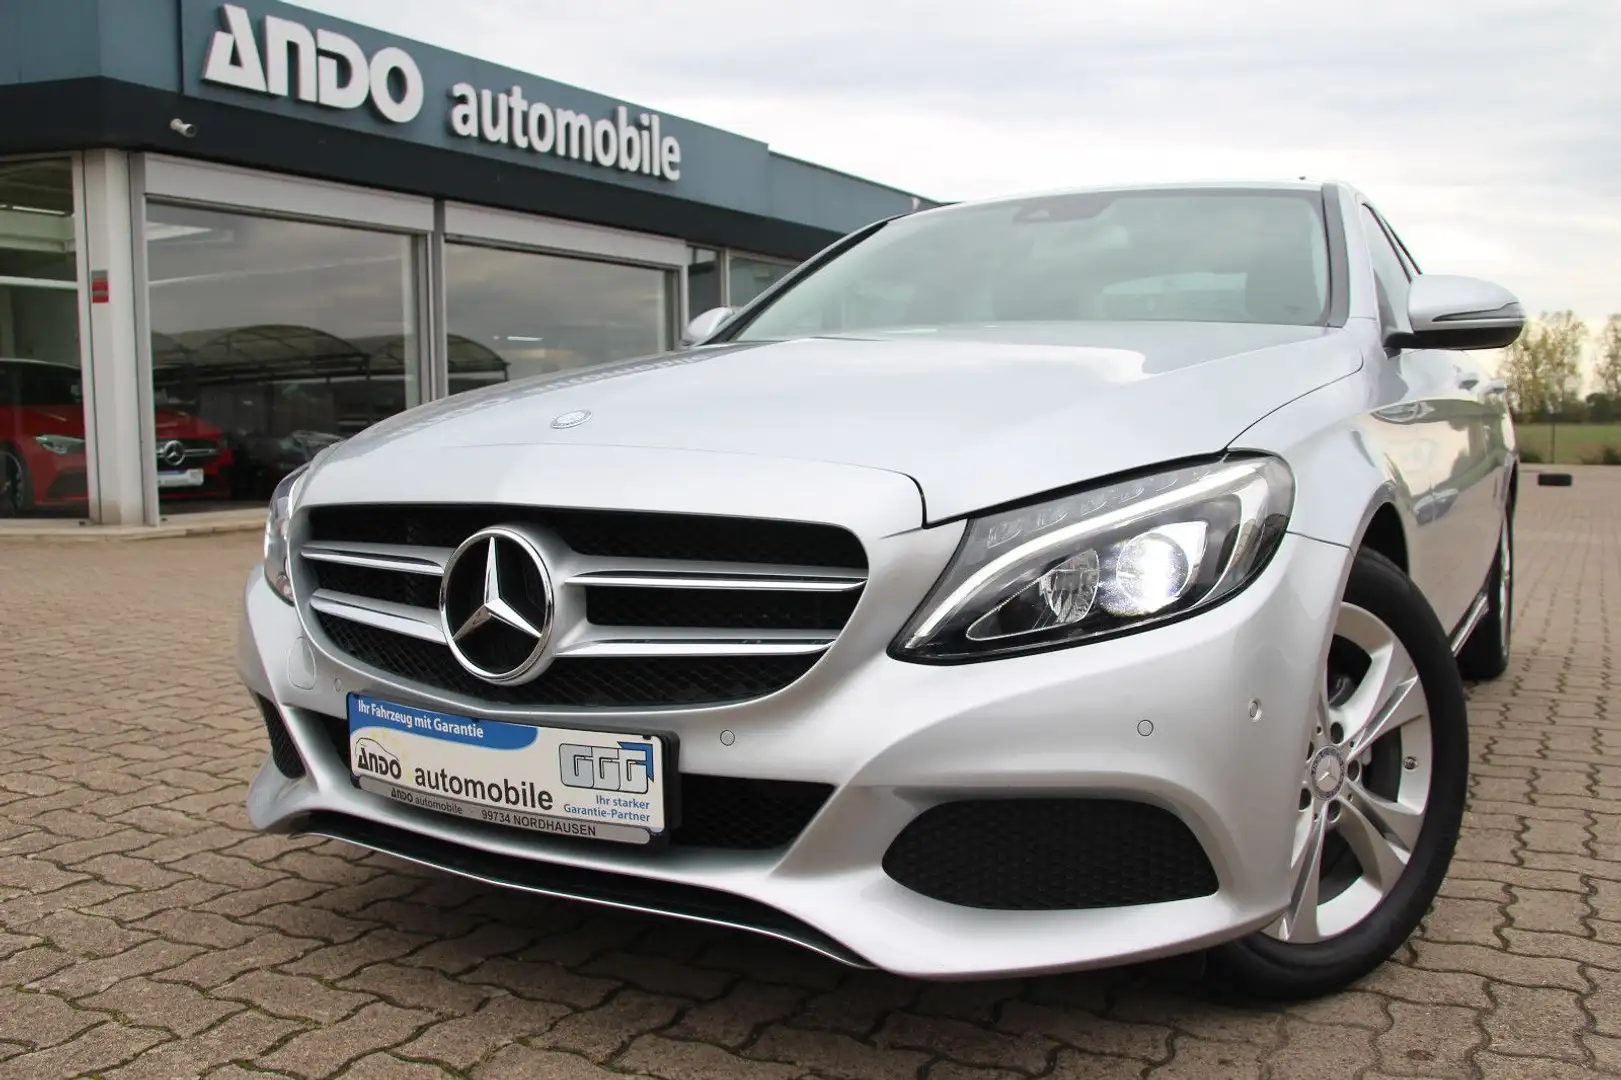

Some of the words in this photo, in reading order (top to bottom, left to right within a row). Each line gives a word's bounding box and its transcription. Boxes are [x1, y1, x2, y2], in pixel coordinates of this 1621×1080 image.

[204, 3, 424, 123] ANDO
[451, 82, 681, 181] automobile
[358, 700, 370, 714] Ihr
[371, 703, 413, 729] Fahrzeug
[414, 715, 432, 730] mit
[433, 718, 484, 739] Garantie
[357, 747, 402, 780] ANDO
[414, 767, 554, 811] automobile
[415, 796, 463, 815] automobile
[481, 809, 511, 824] 99734
[513, 815, 597, 837] NORDHAUSEN
[563, 803, 651, 822] Garantie-Partner
[596, 794, 610, 805] Ihr
[612, 796, 650, 810] starker
